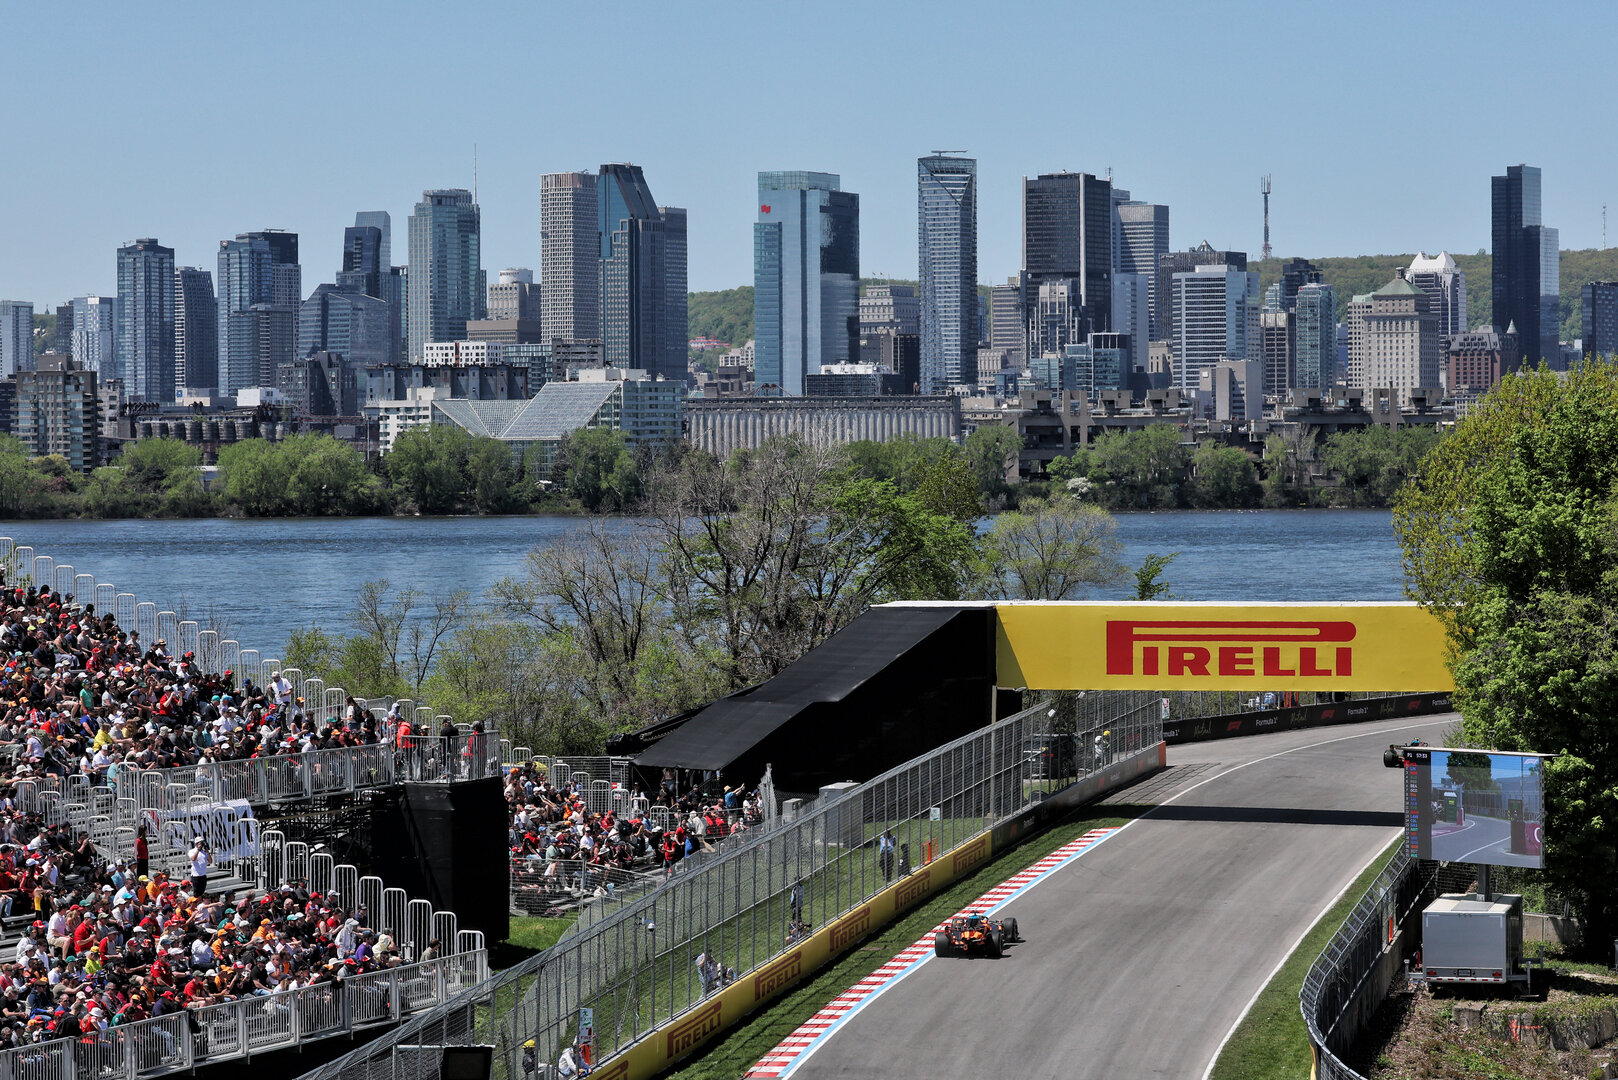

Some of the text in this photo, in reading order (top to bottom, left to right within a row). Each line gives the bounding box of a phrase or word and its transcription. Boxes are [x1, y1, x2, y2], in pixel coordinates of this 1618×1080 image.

[1106, 620, 1357, 676] PIRELLI
[953, 839, 986, 875] PIRELLI
[895, 870, 931, 911] PIRELLI
[830, 906, 871, 953] PIRELLI
[755, 951, 802, 1002] PIRELLI
[667, 1001, 722, 1060] PIRELLI
